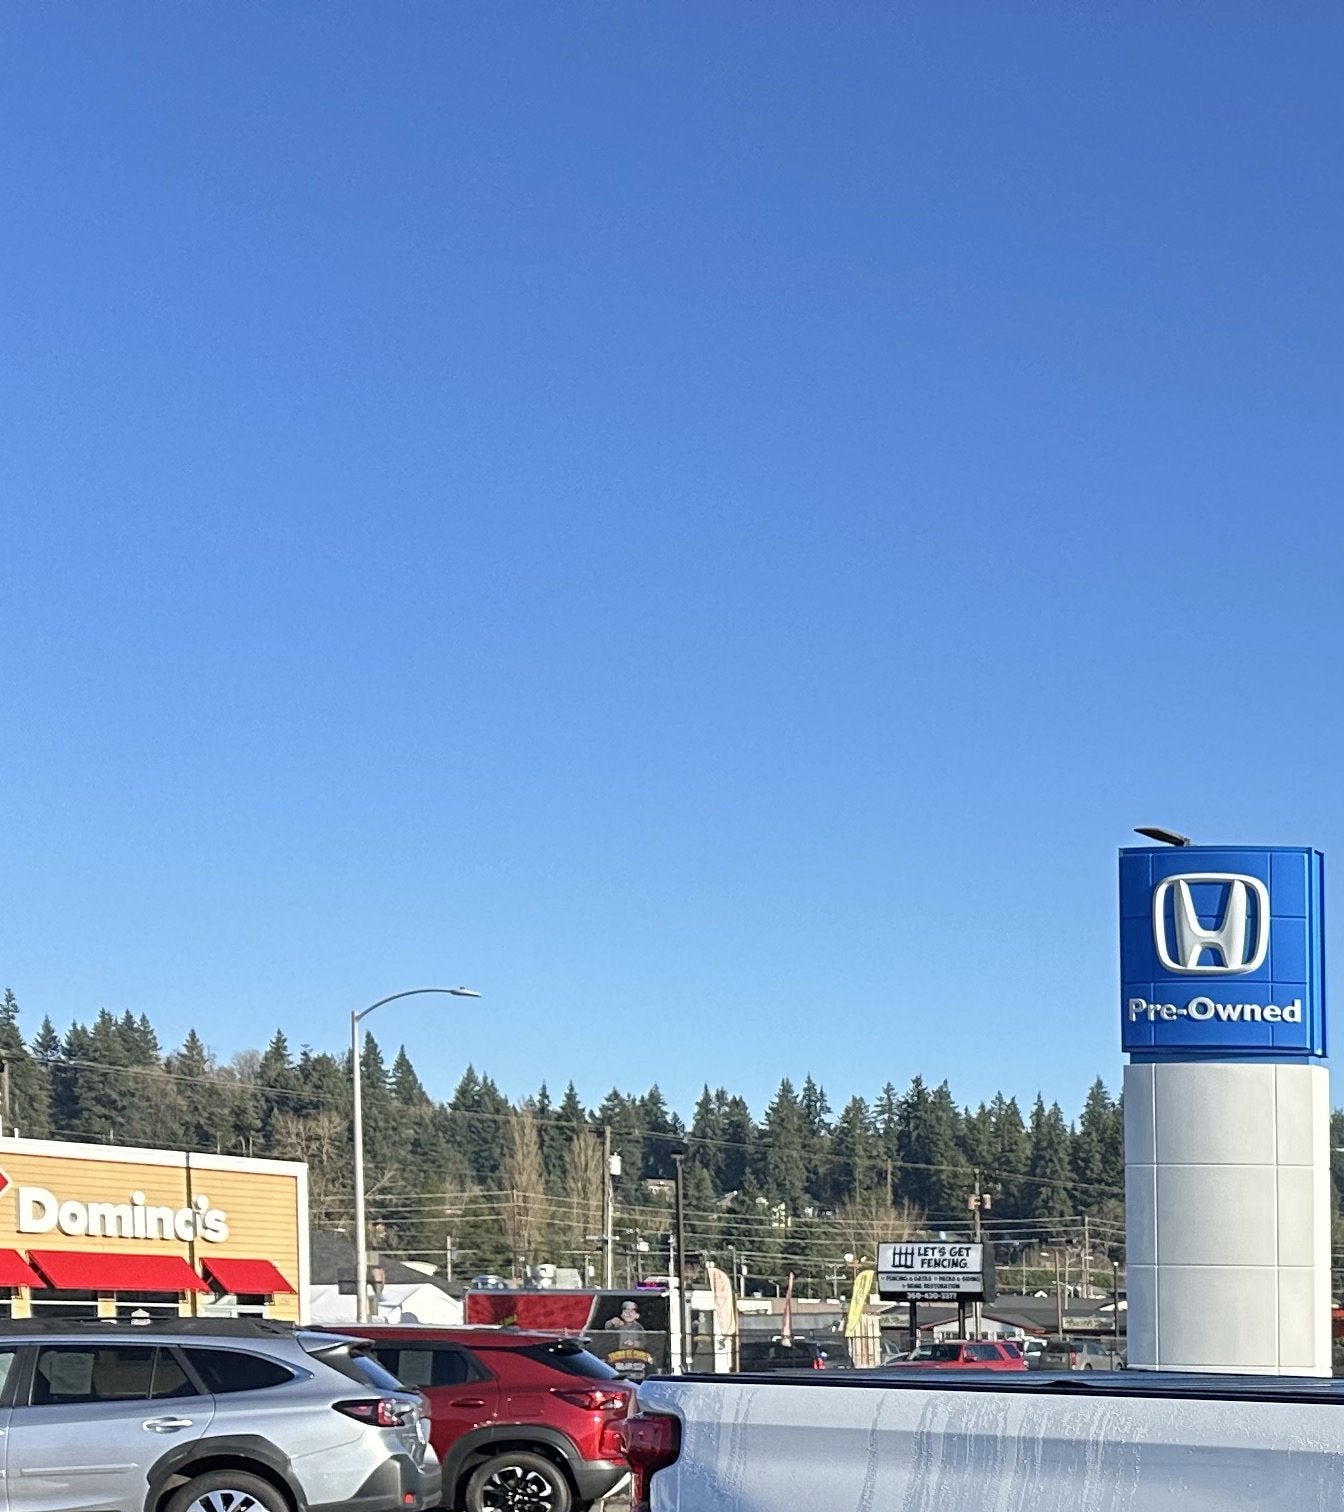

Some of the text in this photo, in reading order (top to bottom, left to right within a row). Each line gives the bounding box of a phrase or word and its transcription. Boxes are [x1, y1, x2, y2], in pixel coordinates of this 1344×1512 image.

[1128, 997, 1302, 1023] Pre-Owned
[17, 1186, 230, 1243] Domino's
[917, 1246, 972, 1257] LET'S GET
[921, 1258, 968, 1269] FENCING
